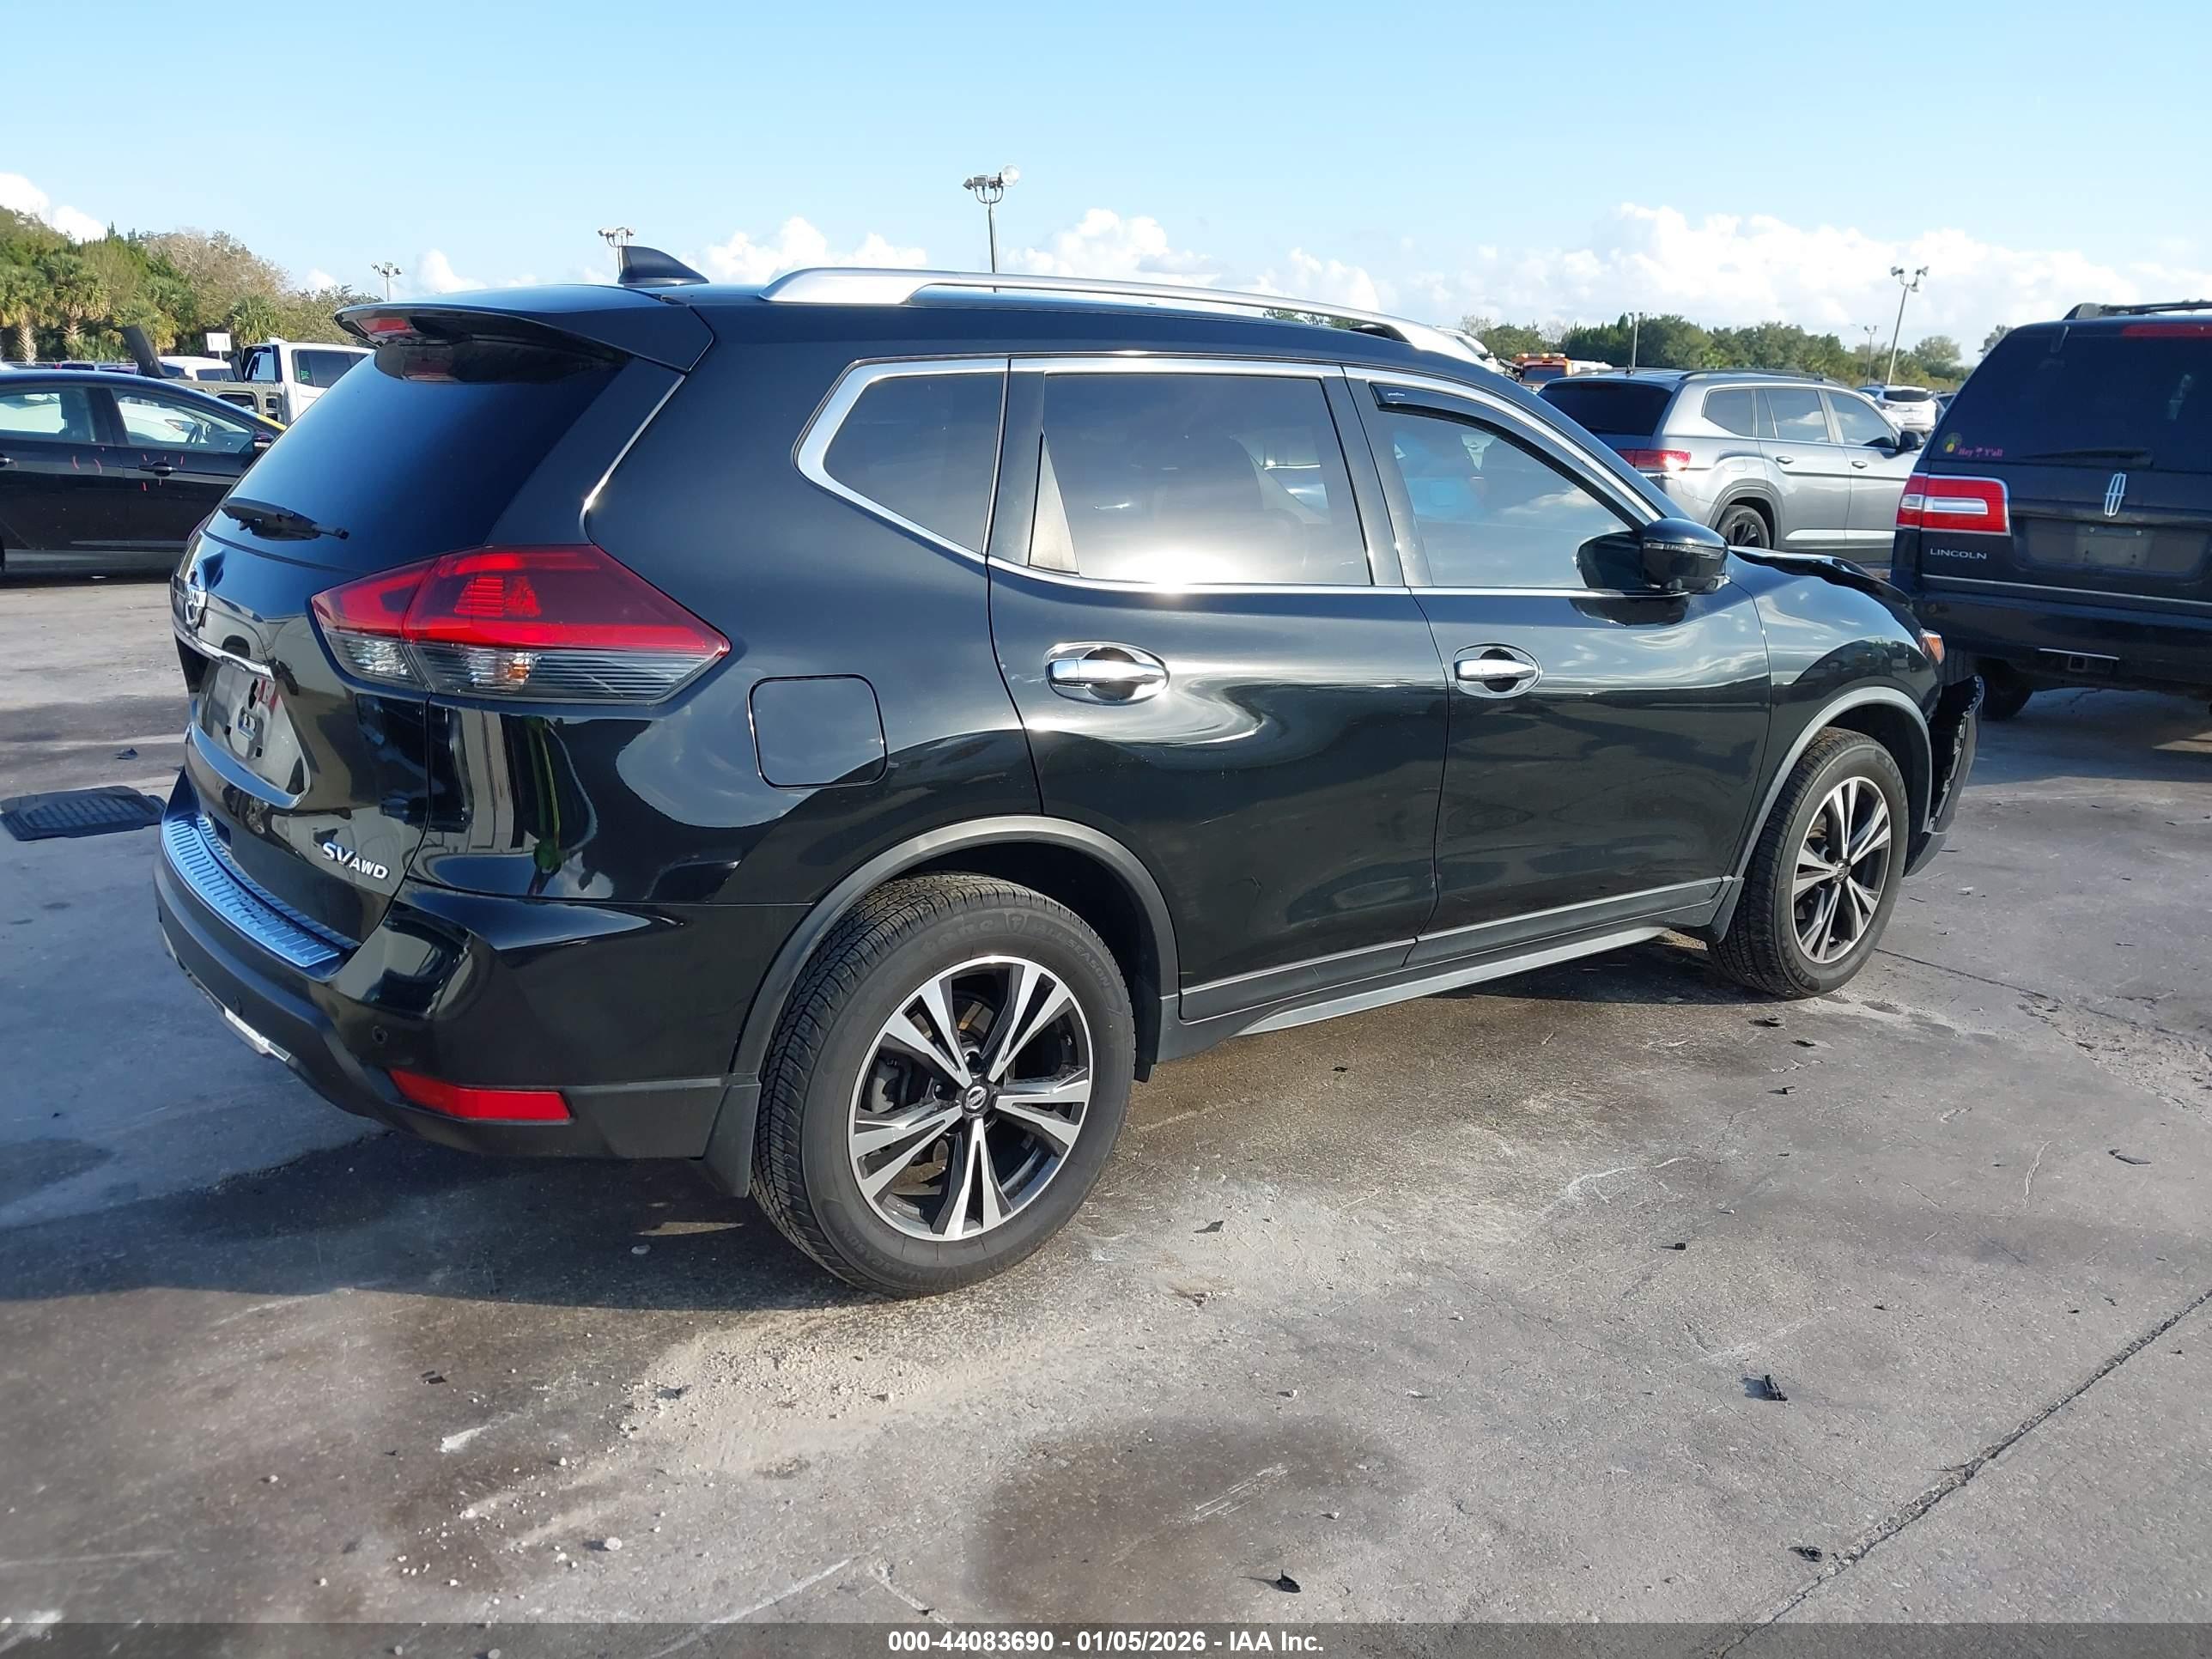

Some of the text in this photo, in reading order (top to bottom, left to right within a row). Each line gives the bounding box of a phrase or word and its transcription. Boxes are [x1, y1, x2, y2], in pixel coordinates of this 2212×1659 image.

[1929, 548, 1988, 560] LINCOLN
[322, 842, 389, 880] SV AWD
